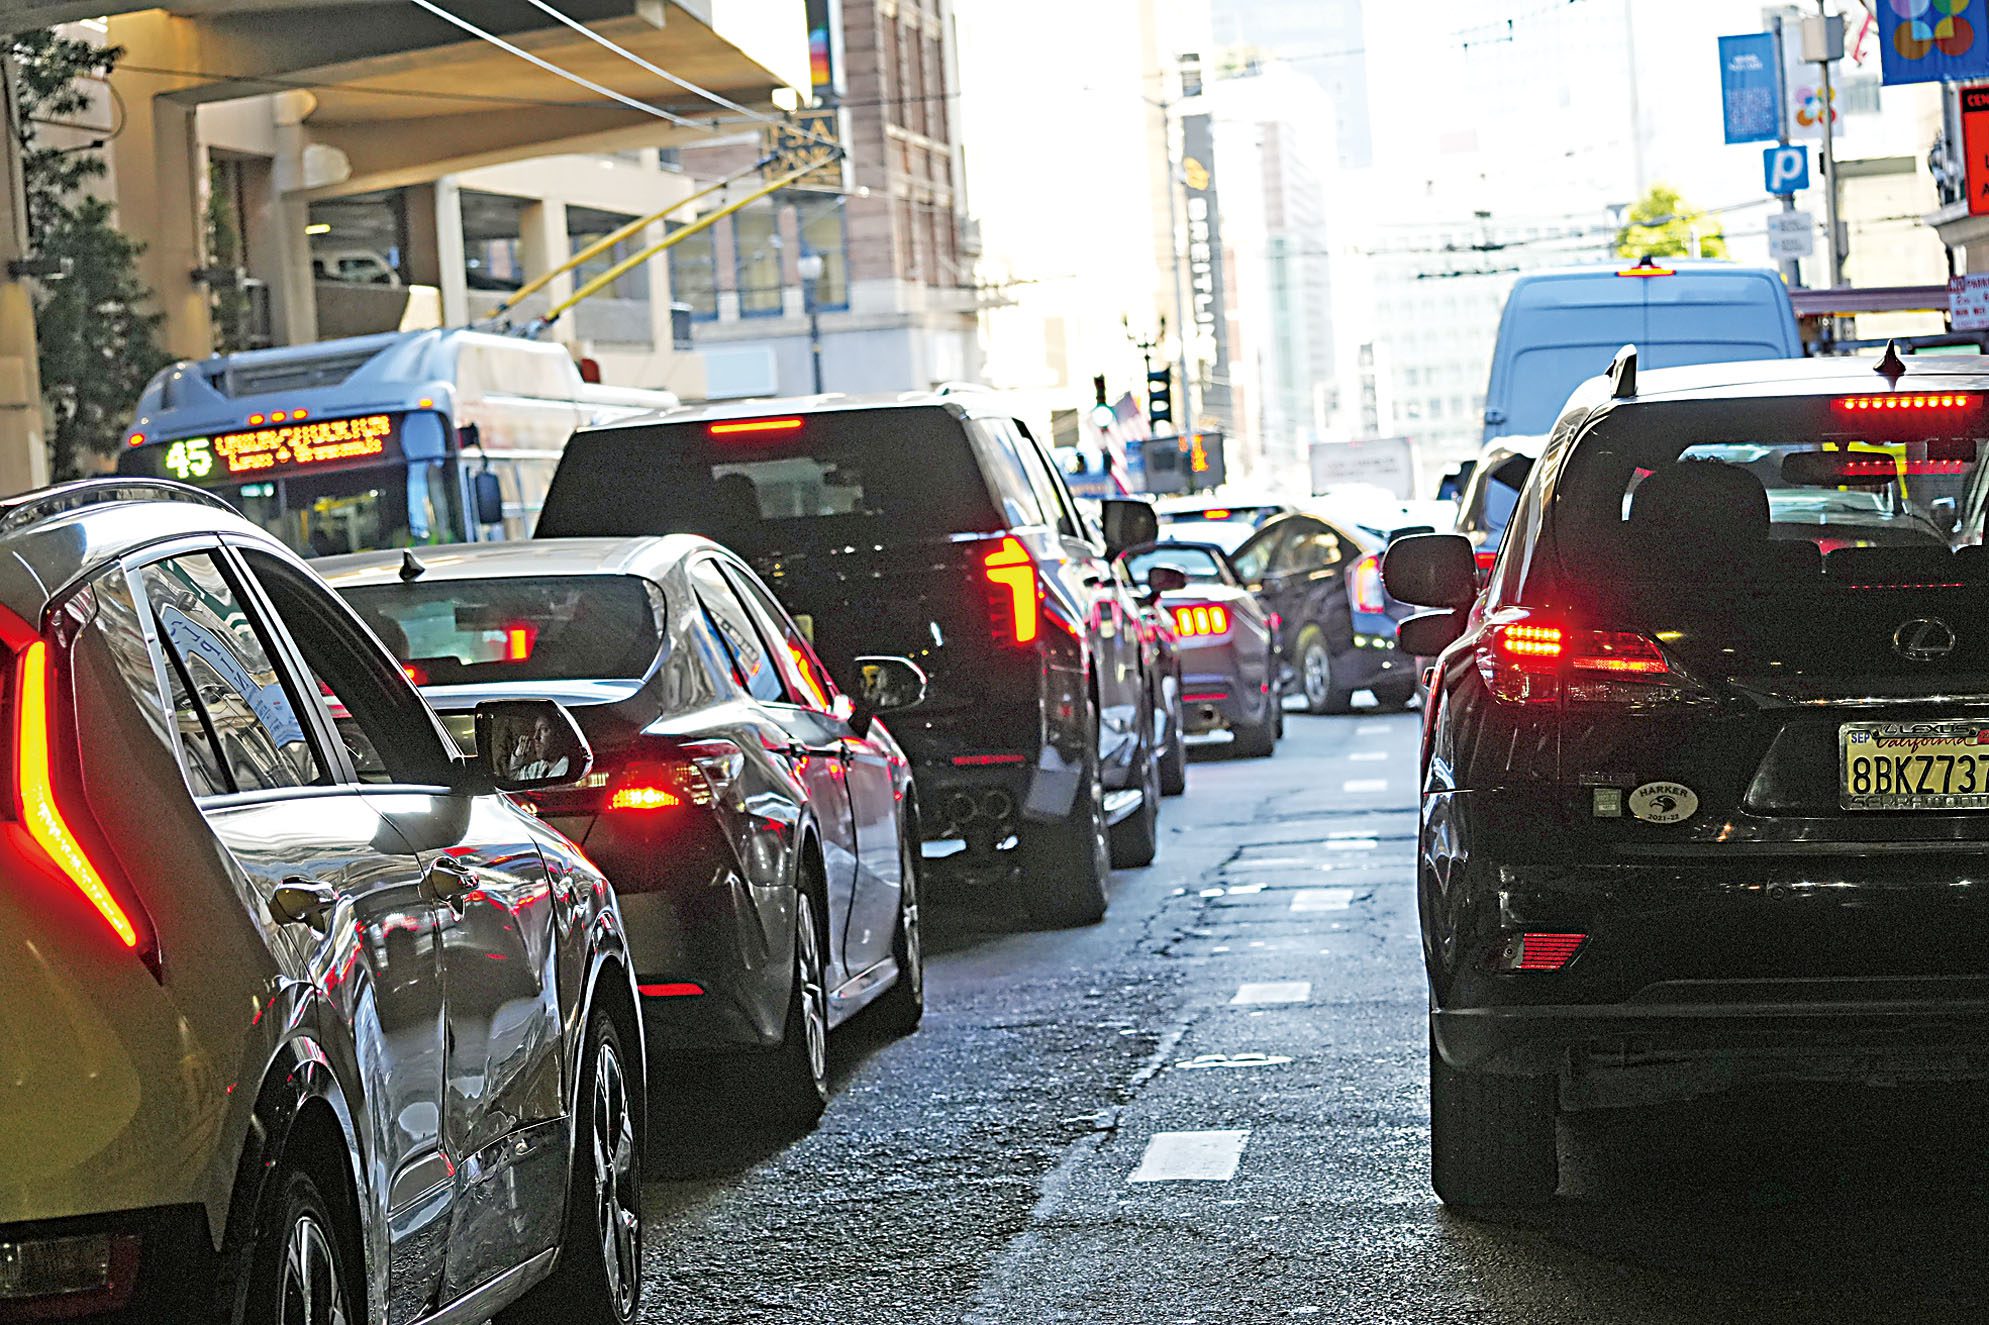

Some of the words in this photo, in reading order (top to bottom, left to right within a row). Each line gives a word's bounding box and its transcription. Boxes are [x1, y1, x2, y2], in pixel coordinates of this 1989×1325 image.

[1771, 148, 1804, 190] P
[166, 438, 213, 478] 45
[1900, 724, 1970, 734] LEXUS
[1851, 732, 1871, 744] SEP
[1639, 785, 1689, 798] HARKER
[1647, 813, 1680, 821] 2021-22
